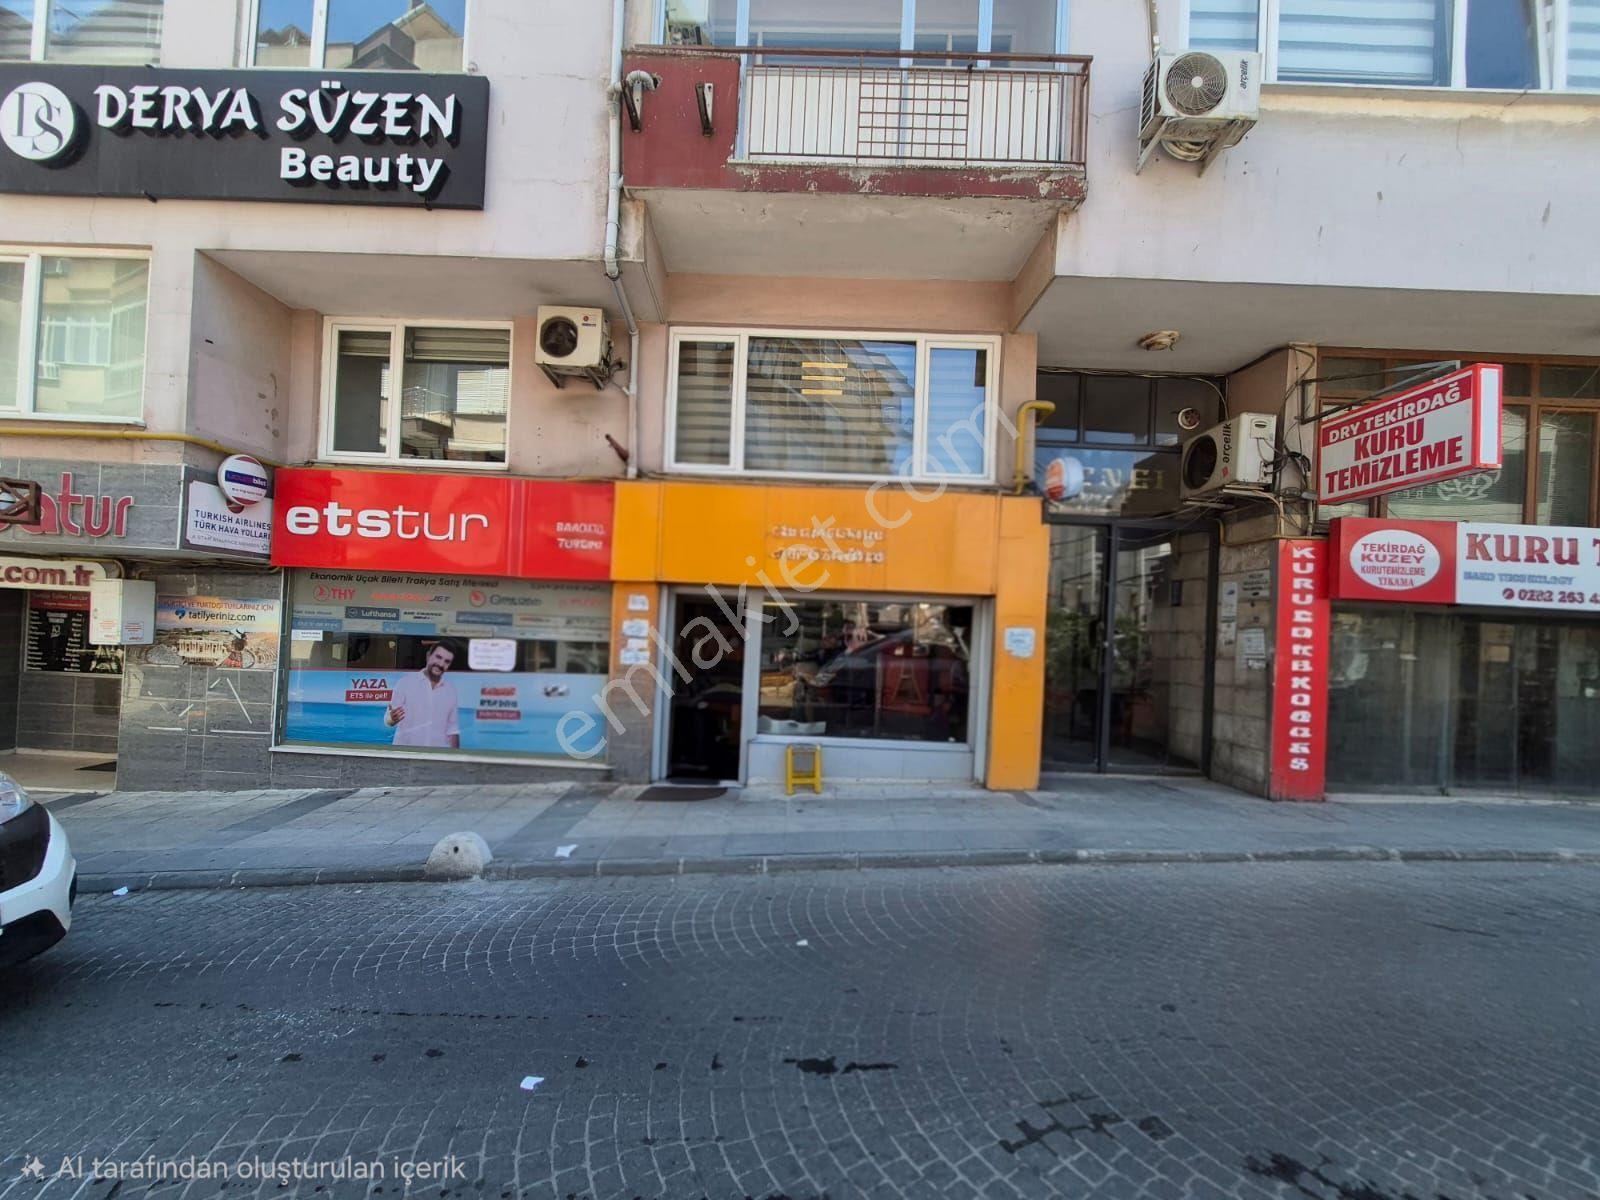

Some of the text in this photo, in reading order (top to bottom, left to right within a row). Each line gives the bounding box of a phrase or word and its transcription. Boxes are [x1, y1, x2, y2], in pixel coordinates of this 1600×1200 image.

[94, 80, 457, 140] DERYA SÜZEN
[280, 147, 445, 192] Beauty
[1328, 381, 1461, 443] DRY TEKİRDAĞ
[1354, 418, 1425, 461] KURU
[194, 509, 271, 531] TURKISH AIRLINES
[194, 519, 271, 540] TÜRK HAVA YOLLARI
[286, 501, 489, 541] etstur
[1361, 541, 1426, 554] TEKİRDAĞ
[1466, 533, 1580, 565] KURU
[1361, 553, 1425, 564] KUZEY
[310, 572, 354, 582] Ekonomik
[355, 575, 378, 584] Uçak
[381, 575, 403, 584] Bileti
[406, 576, 437, 587] Trakya
[331, 588, 356, 599] THY
[188, 610, 256, 622] tatilyeriniz.com
[361, 608, 397, 618] Lufthansa
[351, 678, 388, 689] YAZA
